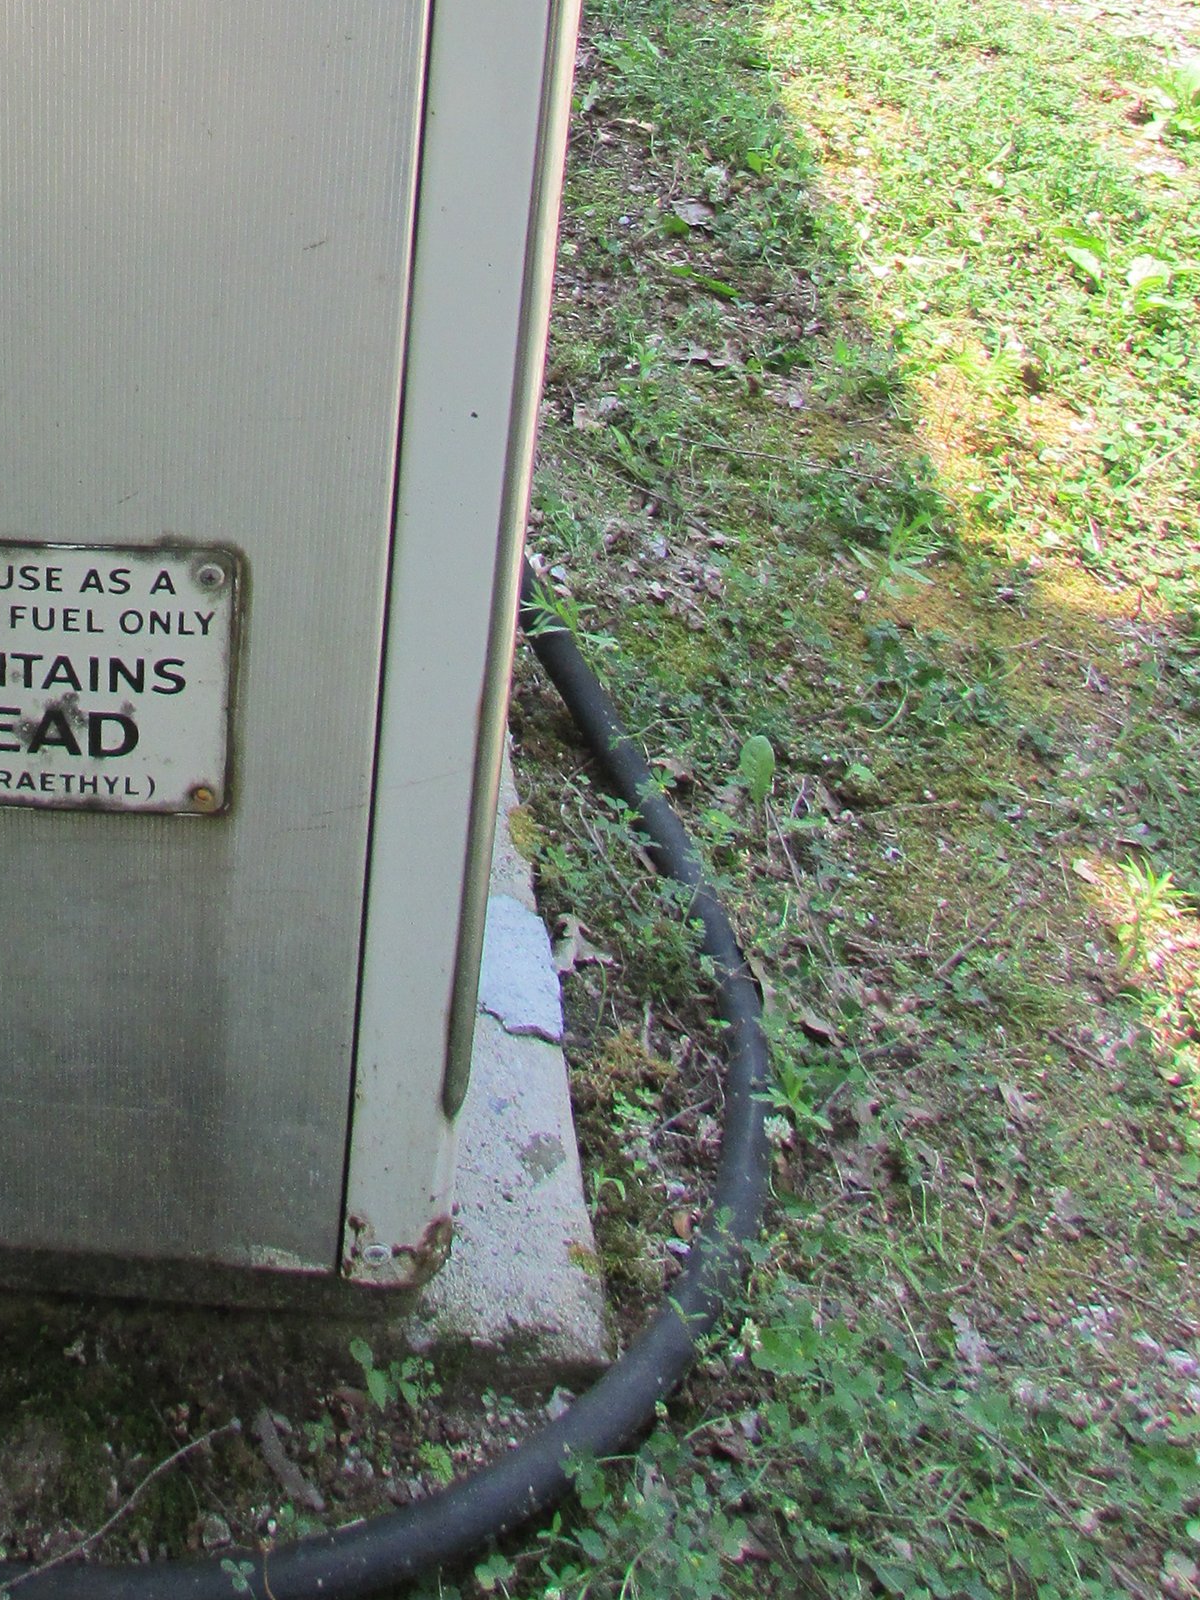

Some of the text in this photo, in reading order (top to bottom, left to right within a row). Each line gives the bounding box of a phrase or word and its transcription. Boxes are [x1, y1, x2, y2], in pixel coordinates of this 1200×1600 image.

[79, 568, 131, 595] AS
[149, 570, 176, 595] A
[9, 605, 104, 633] FUEL
[119, 609, 215, 636] ONLY
